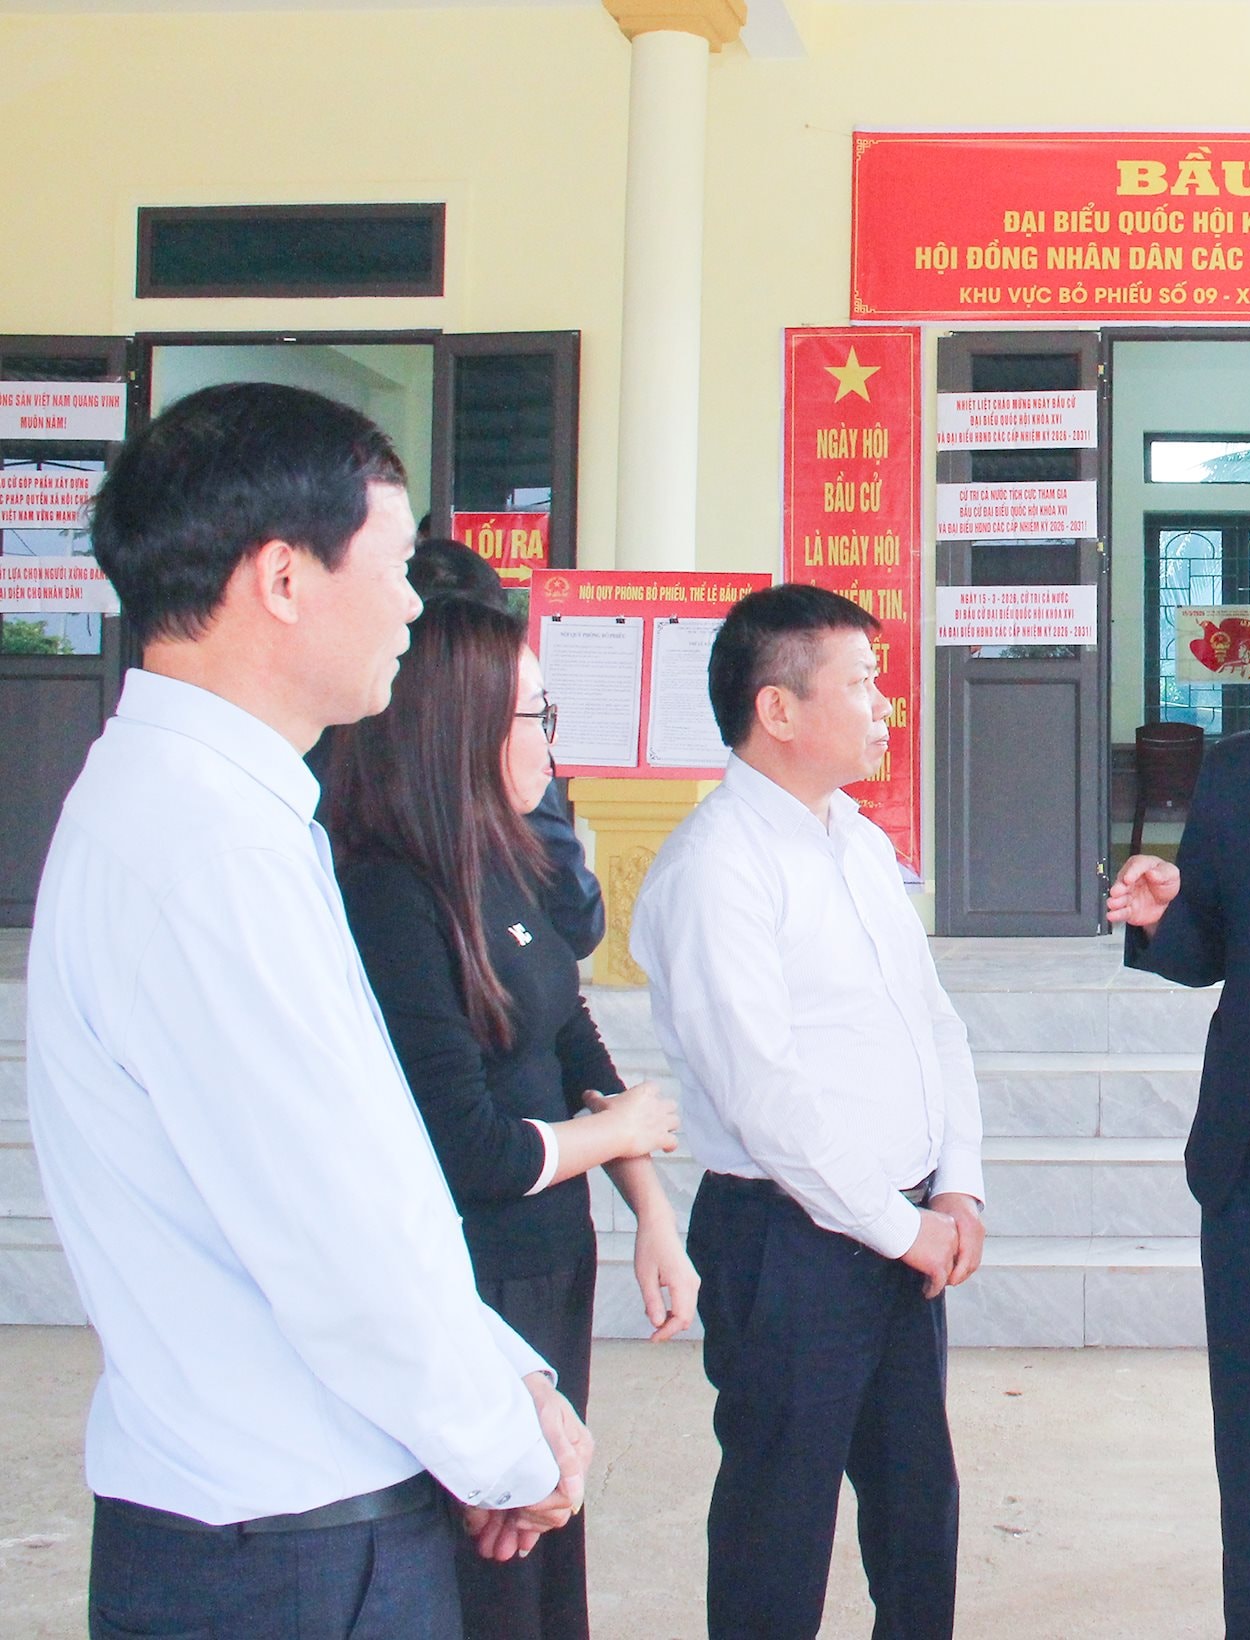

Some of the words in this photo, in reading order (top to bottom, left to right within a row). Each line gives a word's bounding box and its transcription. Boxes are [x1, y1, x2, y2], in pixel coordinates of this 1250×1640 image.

[1003, 210, 1045, 238] ĐẠI
[1053, 202, 1110, 233] BIỂU
[1118, 204, 1184, 235] QUỐC
[1193, 207, 1233, 238] HỘI
[914, 241, 958, 275] HỘI
[966, 238, 1038, 271] ĐỒNG
[1047, 242, 1121, 270] NHÂN
[1129, 242, 1183, 270] DÂN
[1191, 243, 1243, 271] CÁC
[959, 287, 1001, 304] KHU
[1007, 284, 1052, 308] VỰC
[1059, 282, 1088, 304] BỎ
[1094, 281, 1152, 304] PHIẾU
[1158, 281, 1187, 304] SỐ
[1193, 287, 1217, 304] 09
[34, 392, 50, 409] VIỆT
[52, 394, 71, 407] NAM
[72, 394, 99, 409] QUANG
[101, 395, 120, 407] VINH
[817, 422, 858, 459] NGÀY
[862, 422, 888, 465] HỘI
[824, 472, 855, 513] BẦU
[860, 468, 883, 512] CỬ
[511, 529, 544, 560] RA
[804, 529, 823, 566] LÀ
[827, 529, 869, 566] NGÀY
[874, 529, 900, 573] HỘI
[579, 582, 595, 603] NỘI
[596, 585, 612, 601] QUY
[614, 582, 644, 601] PHÒNG
[645, 582, 657, 601] BỎ
[707, 583, 717, 605] LỆ
[878, 589, 907, 624] TIN,
